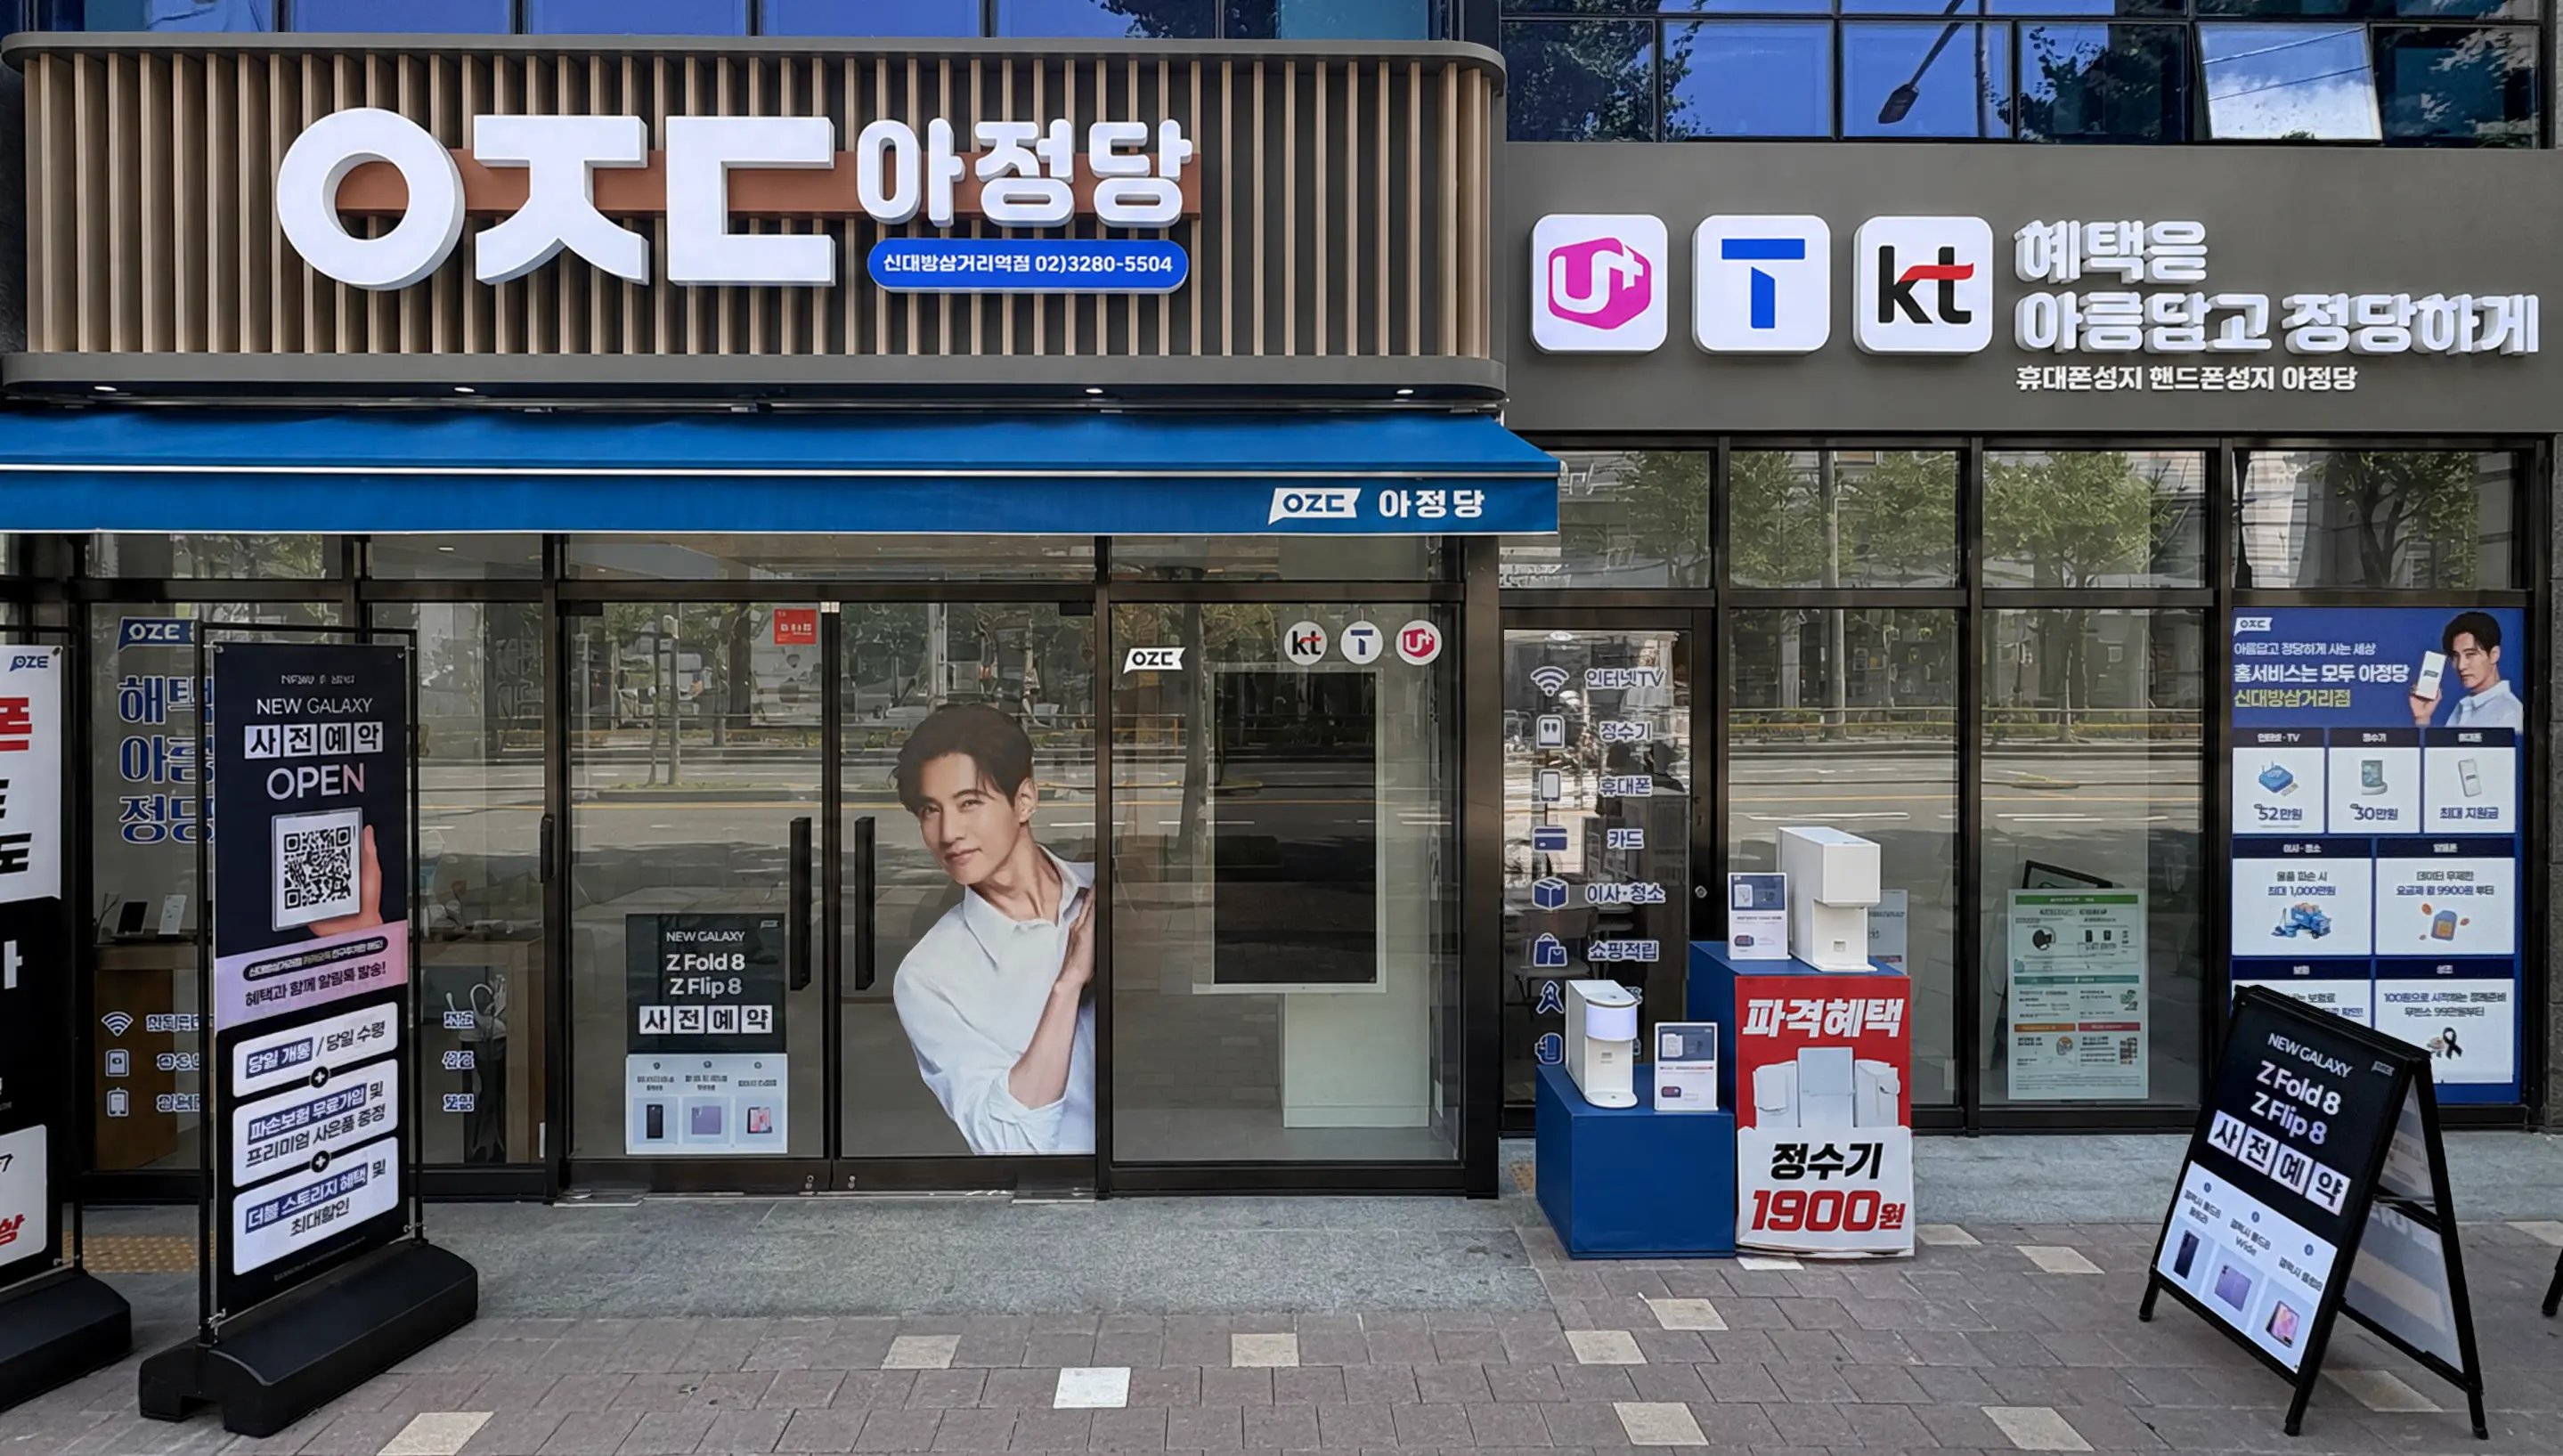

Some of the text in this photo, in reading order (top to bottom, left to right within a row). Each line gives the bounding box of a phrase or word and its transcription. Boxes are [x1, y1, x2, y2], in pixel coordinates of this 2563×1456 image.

[856, 118, 1193, 228] 아정당
[883, 253, 1174, 274] 신대방삼거리역점 02)3280-5504
[2014, 219, 2209, 284] 혜택은
[1721, 238, 1806, 329] T
[1877, 244, 1974, 325] kt
[2014, 291, 2540, 356] 아름답고 정당하게
[2015, 365, 2358, 392] 휴대폰성지 핸드폰성지 아정당
[1379, 489, 1485, 519] 아정당
[1291, 630, 1322, 655] kt
[1349, 629, 1374, 655] T
[2329, 642, 2352, 656] 사는
[2354, 642, 2377, 656] 세상
[1585, 669, 1665, 689] 인터넷TV
[2233, 663, 2411, 684] 홈서비스는 모두 아정당
[256, 697, 373, 715] NEW GALAXY
[2233, 689, 2352, 708] 신대방삼거리점
[246, 722, 382, 757] 사전예약
[1600, 721, 1653, 742] 정수기
[266, 762, 365, 800] OPEN
[1599, 776, 1653, 796] 휴대폰
[2258, 807, 2302, 821] 52만원
[2354, 807, 2399, 821] 30만원
[2440, 807, 2499, 820] 최대 지원금
[1608, 829, 1645, 850] 카드
[1585, 883, 1665, 904] 이사·청소
[666, 931, 745, 942] NEW GALAXY
[666, 953, 745, 972] Z Fold 8
[1588, 941, 1659, 962] 쇼핑적립
[670, 977, 742, 998] Z Flip 8
[641, 1007, 771, 1032] 사전예약
[1743, 998, 1906, 1039] 파격혜택
[248, 1050, 279, 1073] 당일
[327, 1029, 354, 1052] 당일
[356, 1021, 386, 1042] 수령
[2267, 1033, 2301, 1056] NEW
[2299, 1046, 2353, 1078] GALAXY
[2256, 1060, 2341, 1115] Z Fold 8
[249, 1081, 384, 1141] 파손보험 무료가입 및
[2250, 1091, 2327, 1145] Z Flip 8
[246, 1130, 310, 1167] 프리미엄
[313, 1115, 355, 1144] 사은품
[1770, 1142, 1884, 1181] 정수기
[2212, 1117, 2346, 1209] 사전예약
[281, 1178, 338, 1216] 스토리지
[340, 1167, 367, 1191] 혜택
[372, 1159, 386, 1179] 및
[1752, 1190, 1907, 1232] 1900원
